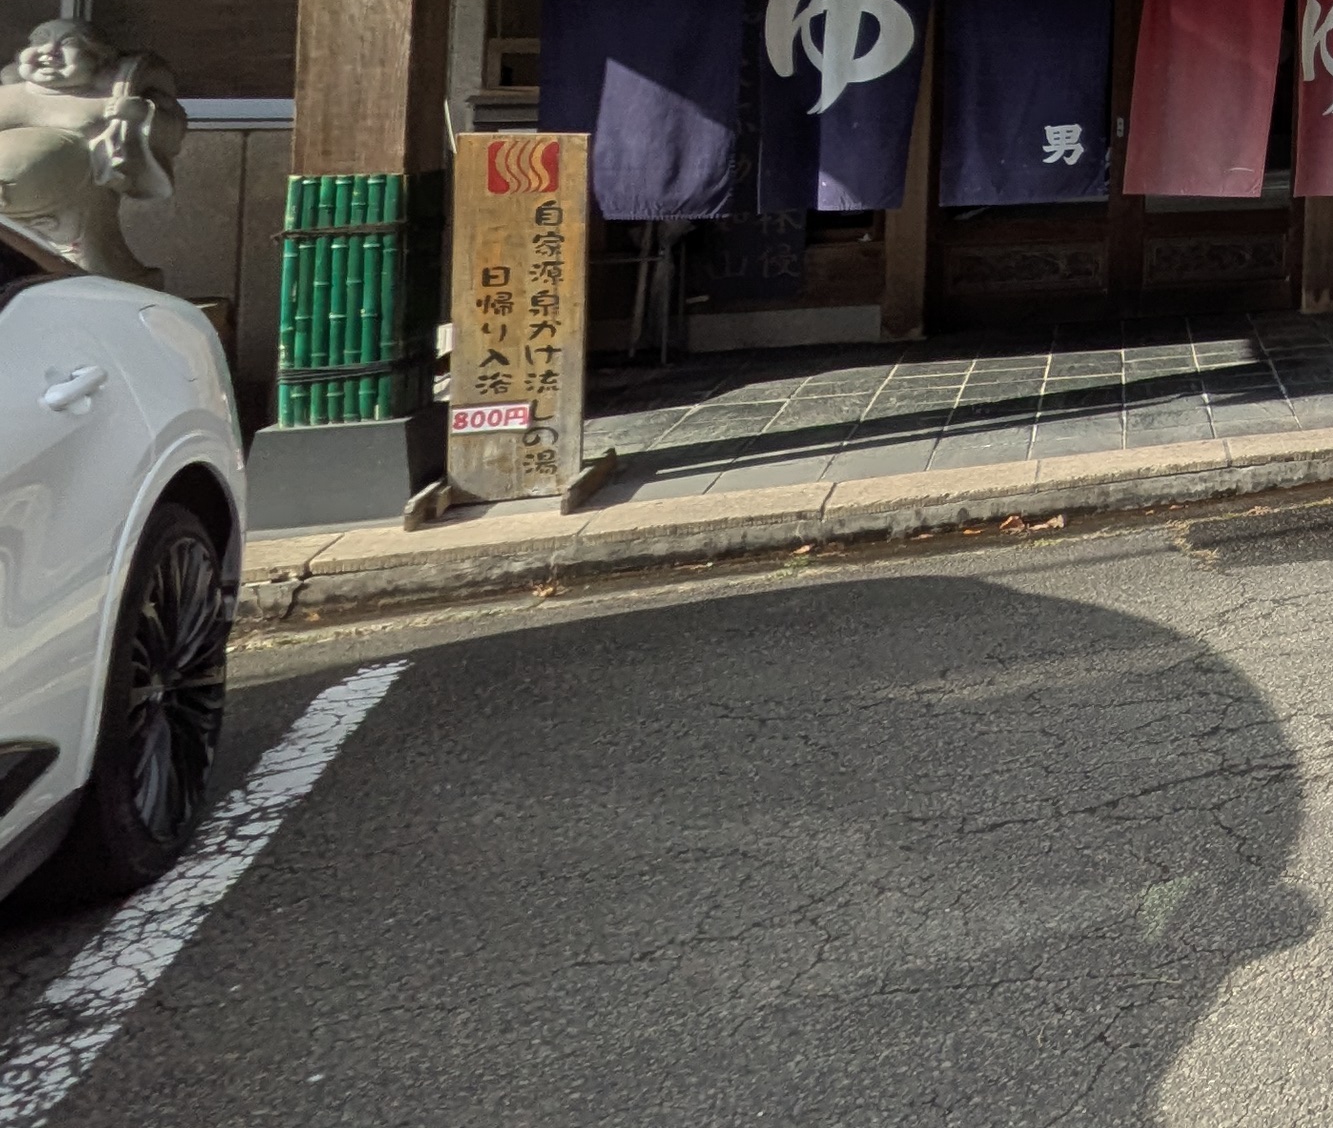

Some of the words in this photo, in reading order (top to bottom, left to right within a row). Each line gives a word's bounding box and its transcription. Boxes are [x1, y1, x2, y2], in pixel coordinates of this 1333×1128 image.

[1042, 124, 1084, 167] 男
[476, 266, 515, 395] 日帰り入浴
[522, 200, 565, 475] 自家源泉かけ流しの湯
[452, 406, 530, 429] 800円
